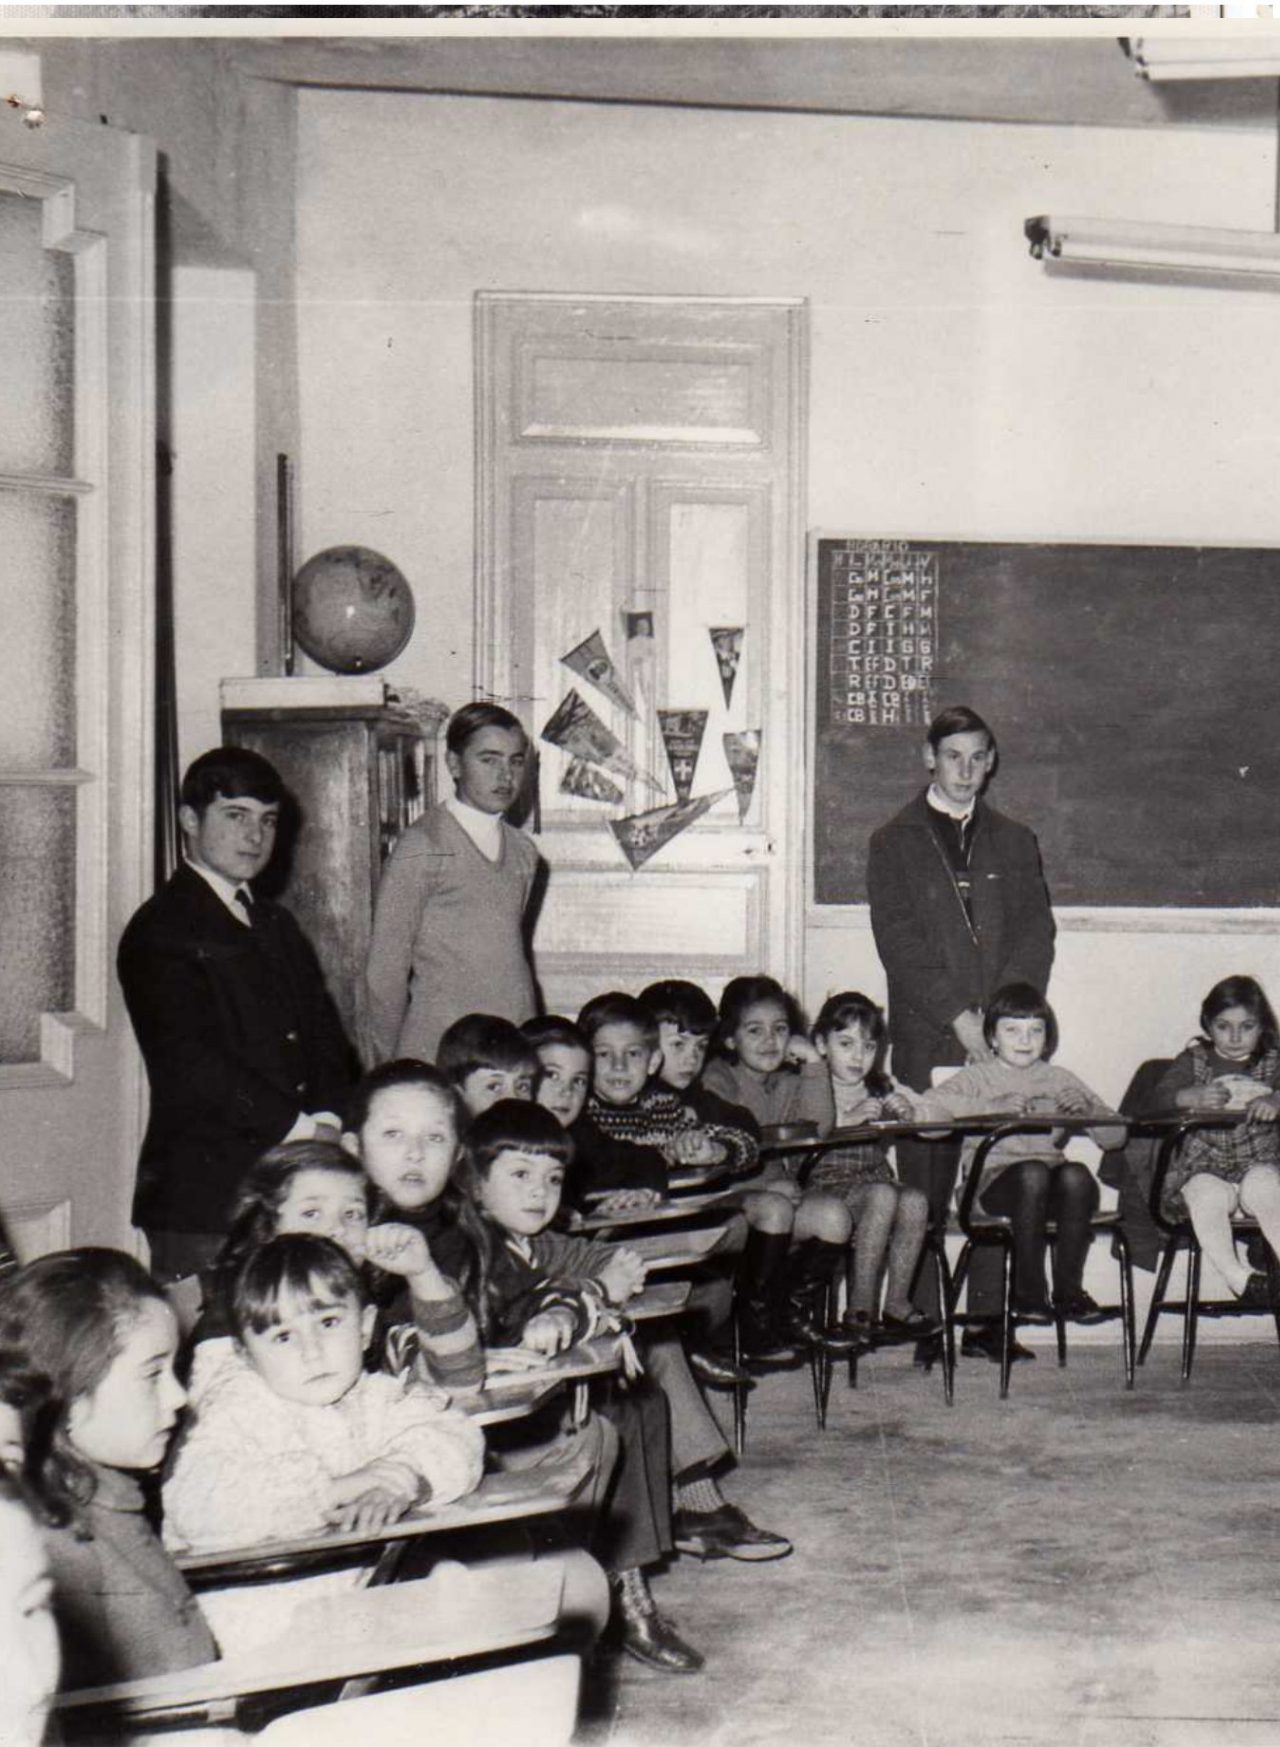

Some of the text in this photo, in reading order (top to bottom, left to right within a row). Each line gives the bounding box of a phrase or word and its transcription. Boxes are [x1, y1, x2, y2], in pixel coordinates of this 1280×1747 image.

[849, 554, 862, 566] L
[920, 554, 932, 567] V
[848, 604, 860, 619] D
[867, 605, 878, 619] F
[884, 604, 896, 619] C
[903, 606, 913, 619] F
[849, 622, 861, 636] D
[866, 622, 877, 636] F
[886, 622, 895, 636] I
[848, 639, 861, 654] C
[868, 640, 875, 654] I
[886, 639, 894, 653] I
[848, 656, 861, 671] T
[883, 656, 896, 671] D
[901, 656, 912, 671] T
[921, 656, 933, 671] R
[849, 674, 861, 689] R
[883, 674, 896, 690] D
[882, 709, 895, 723] H
